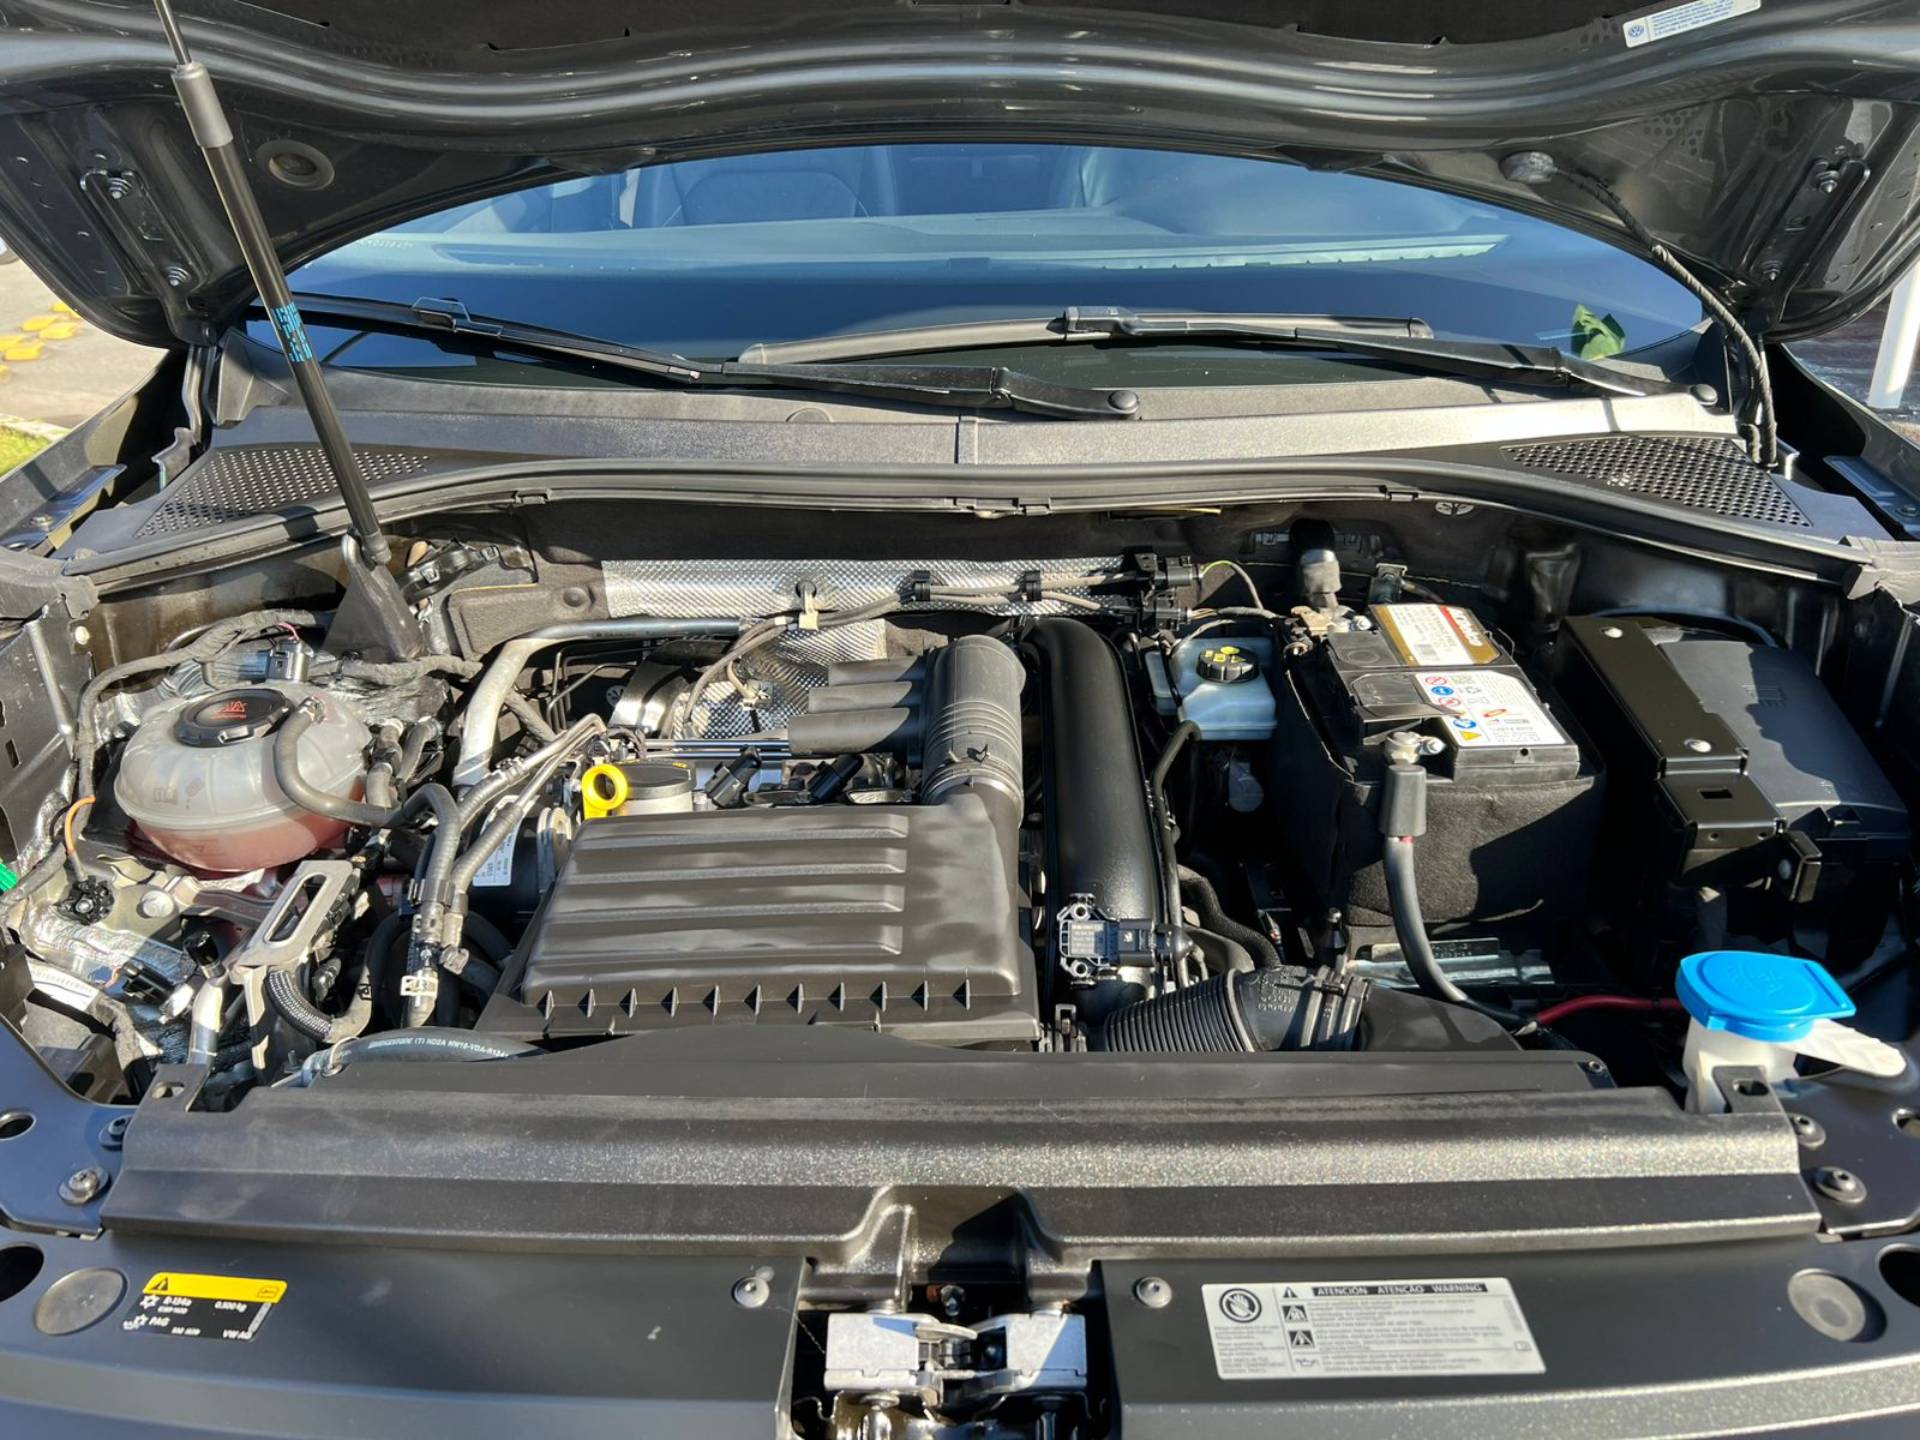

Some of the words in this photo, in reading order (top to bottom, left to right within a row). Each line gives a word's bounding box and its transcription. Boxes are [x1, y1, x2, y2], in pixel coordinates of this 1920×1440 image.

[1432, 1284, 1482, 1293] WARNING
[148, 1316, 170, 1326] PAG
[222, 1329, 239, 1338] VW
